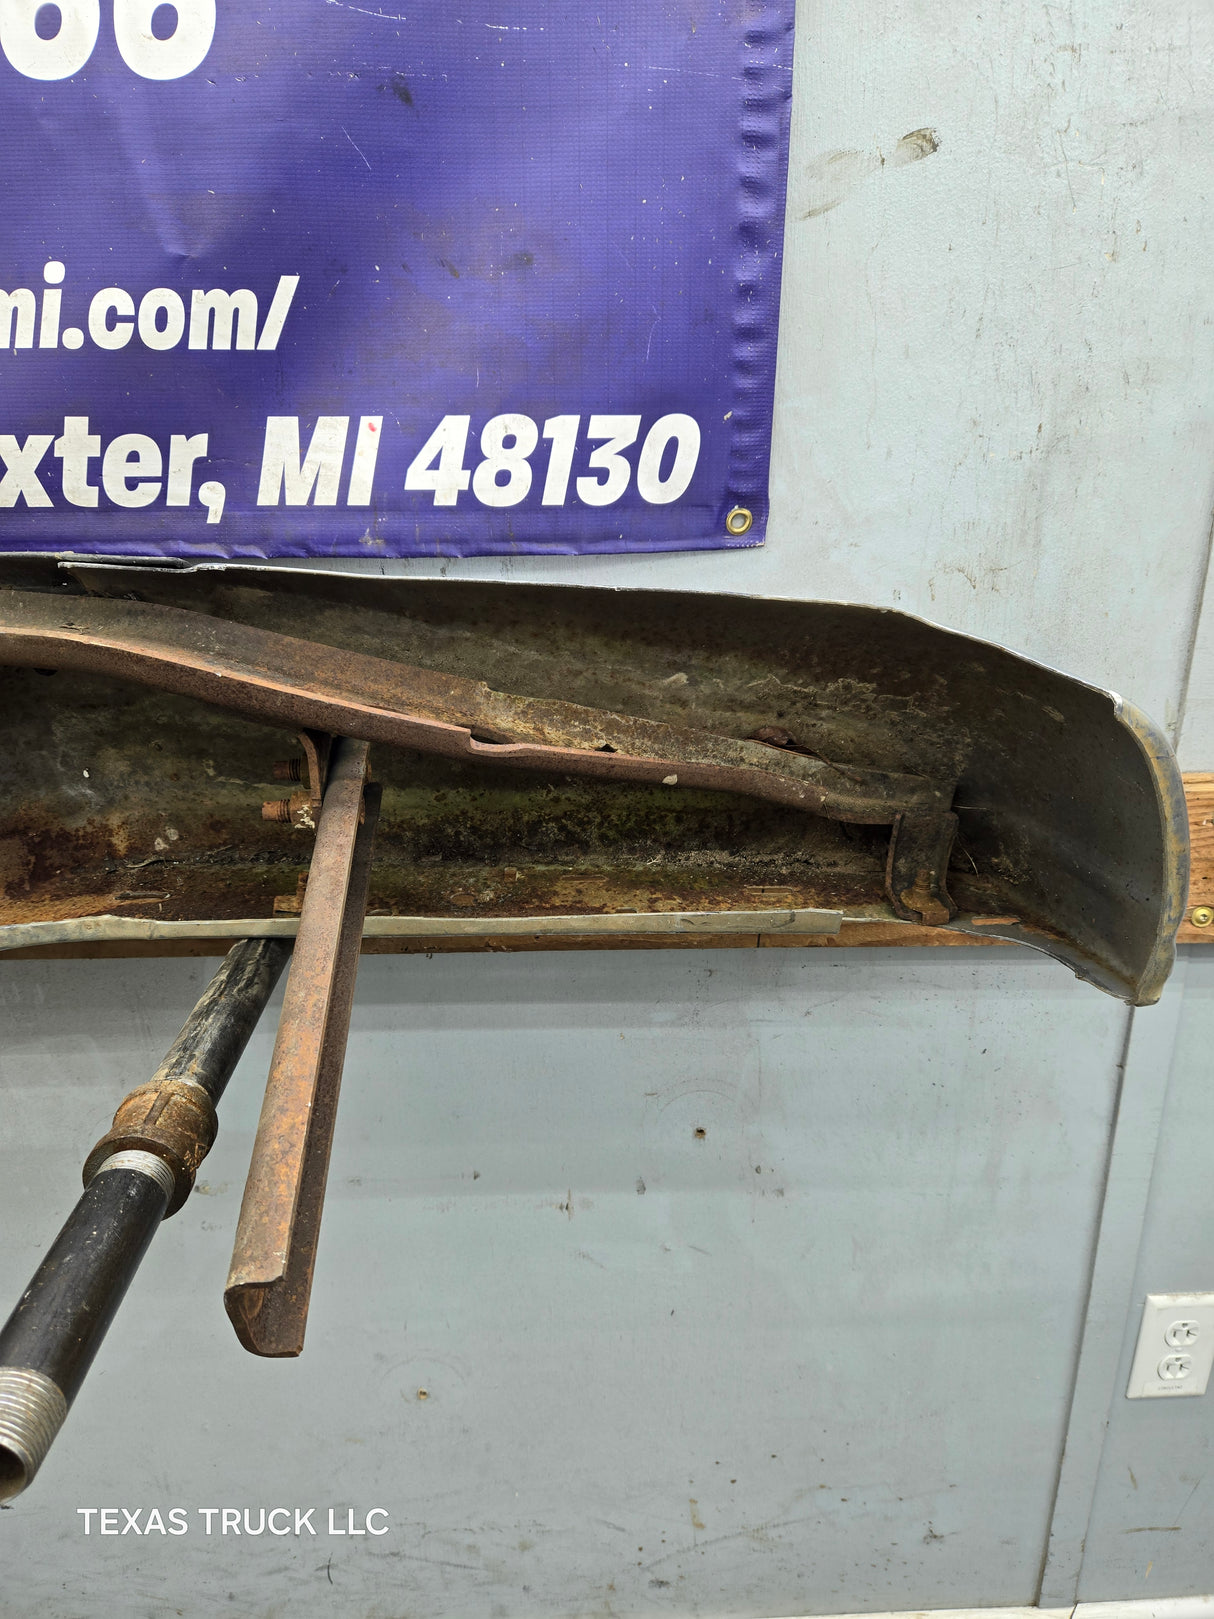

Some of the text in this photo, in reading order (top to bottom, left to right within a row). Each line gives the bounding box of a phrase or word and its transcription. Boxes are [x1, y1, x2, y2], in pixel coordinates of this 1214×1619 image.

[0, 413, 701, 524] xter, MI 48130
